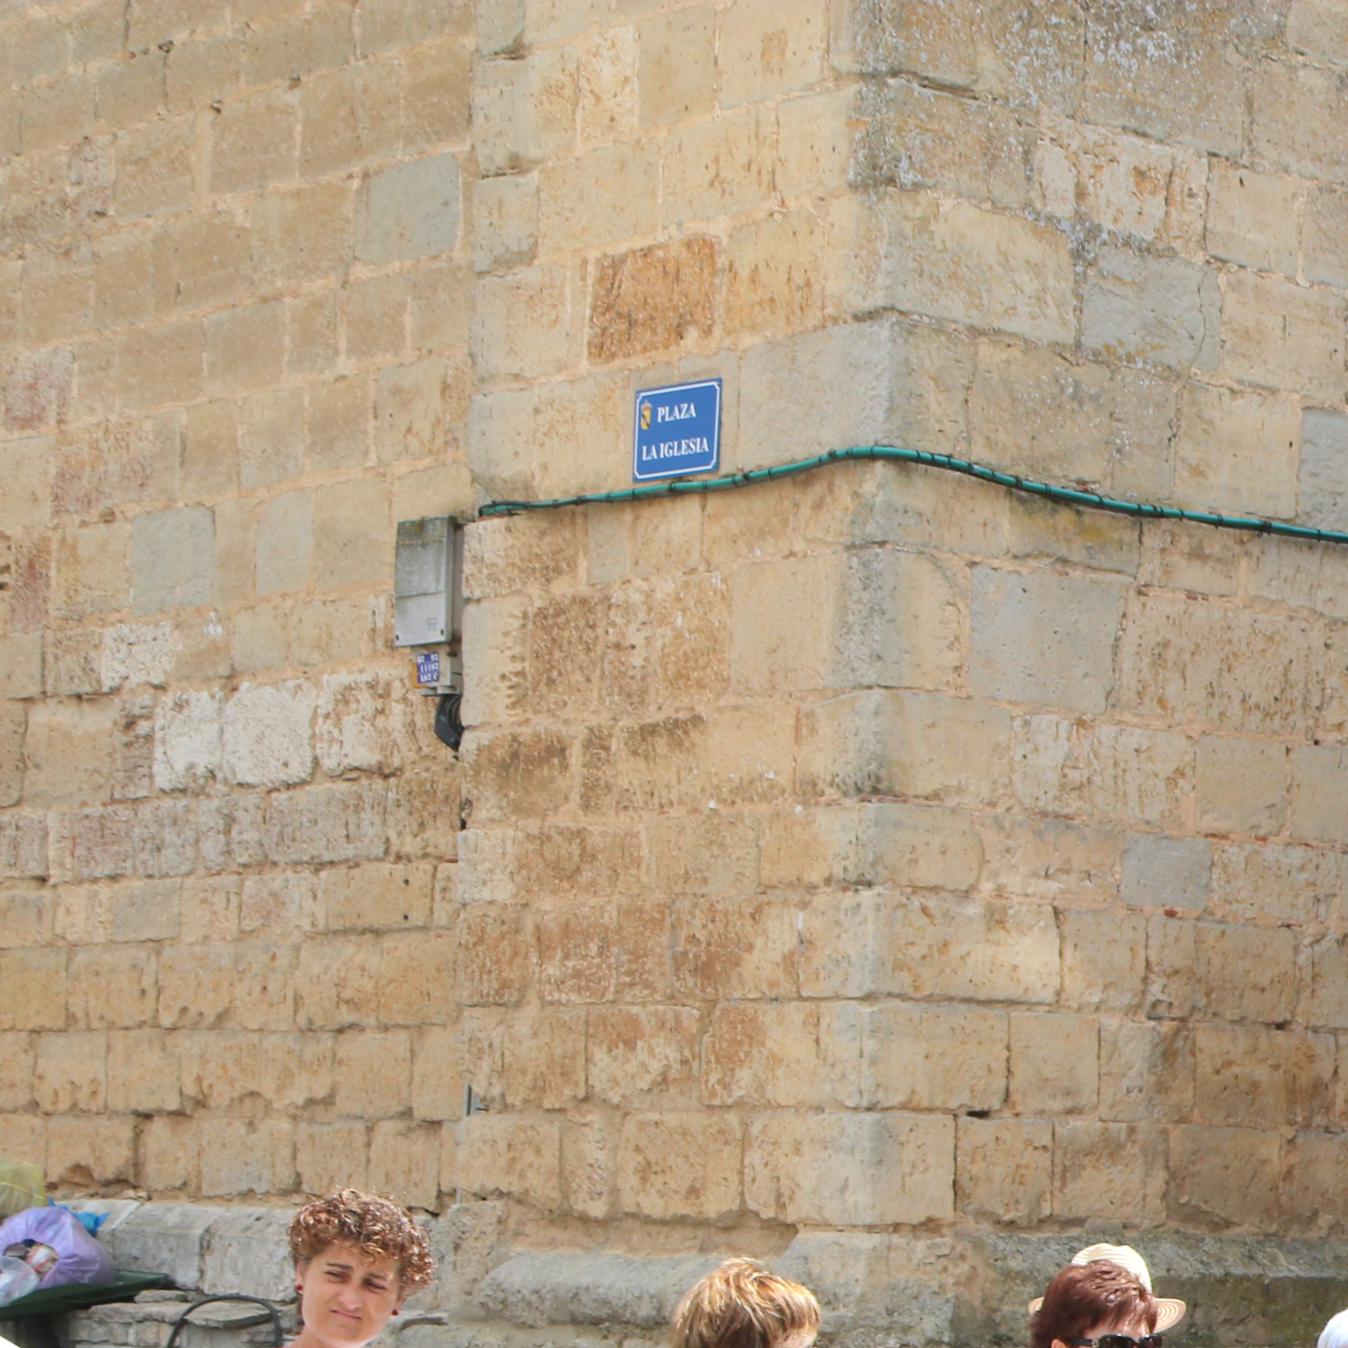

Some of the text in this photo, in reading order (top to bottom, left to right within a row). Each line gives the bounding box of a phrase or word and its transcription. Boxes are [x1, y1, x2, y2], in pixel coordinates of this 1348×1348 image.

[657, 402, 696, 423] PLAZA
[641, 437, 709, 461] LA IGLESIA
